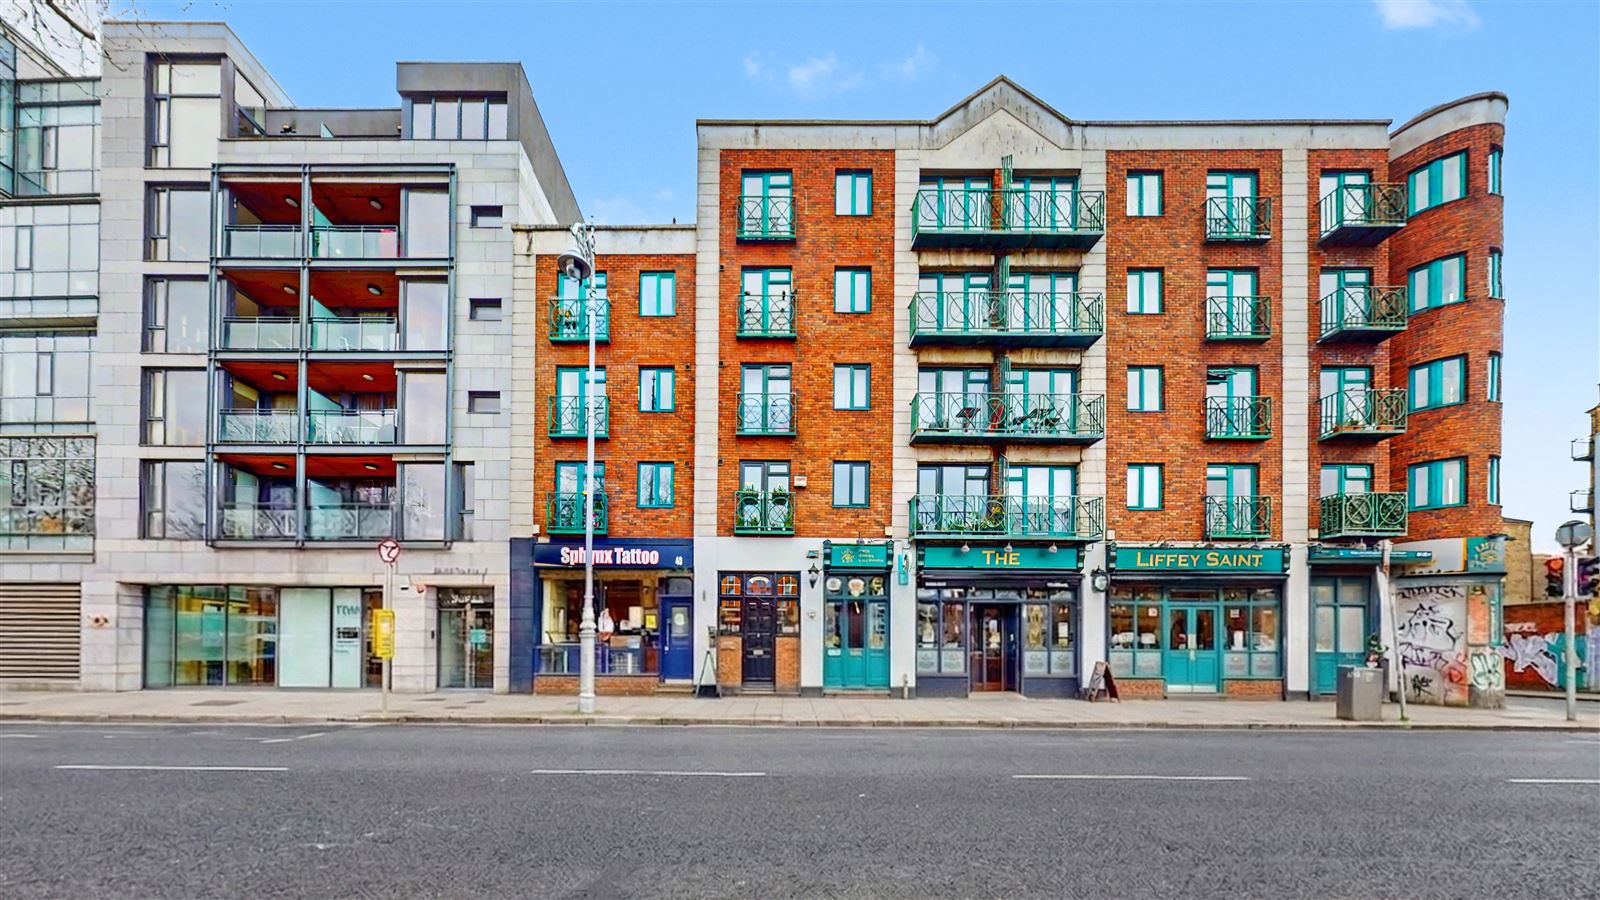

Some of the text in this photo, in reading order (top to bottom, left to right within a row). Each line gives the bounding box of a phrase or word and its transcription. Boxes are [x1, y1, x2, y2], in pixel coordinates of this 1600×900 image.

[614, 547, 659, 565] Tattoo
[982, 550, 1020, 565] THE
[1136, 551, 1263, 567] LIFFEY SAINT
